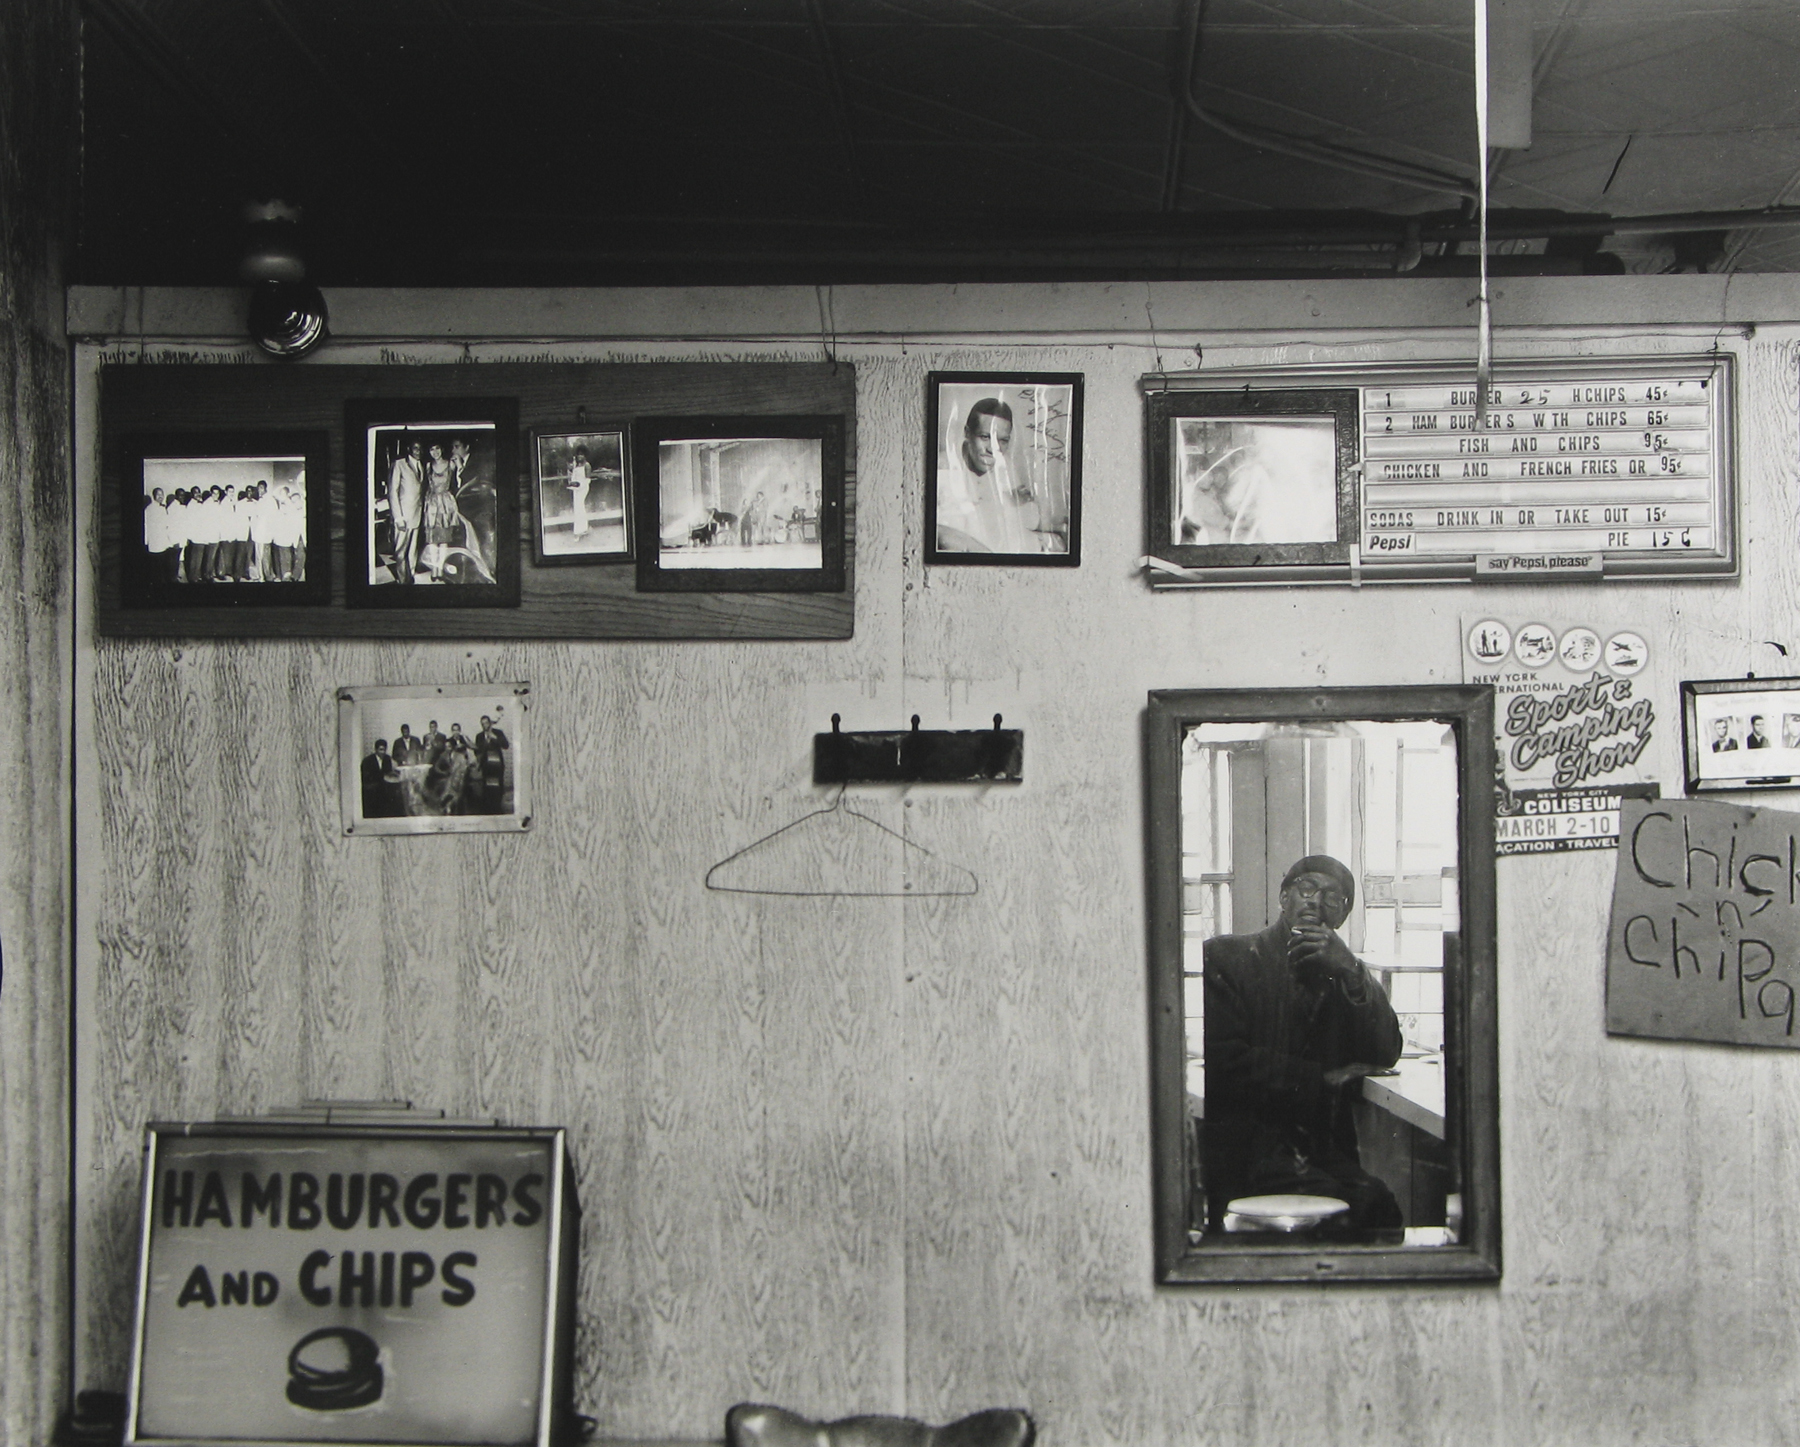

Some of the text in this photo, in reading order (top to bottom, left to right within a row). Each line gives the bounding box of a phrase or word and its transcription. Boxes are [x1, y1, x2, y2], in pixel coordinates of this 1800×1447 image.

[1385, 392, 1392, 407] 1
[1451, 389, 1502, 405] BURER
[1646, 386, 1668, 401] 45¢
[1385, 416, 1393, 431] 2
[1412, 415, 1438, 430] HAM
[1450, 413, 1514, 431] BURERS
[1586, 410, 1627, 427] CHIPS
[1647, 410, 1668, 426] 65¢
[1459, 438, 1489, 453] FISH
[1512, 437, 1537, 453] AND
[1558, 435, 1600, 451] CHIPS
[1383, 455, 1682, 479] CHICKEN AND FRENCH FRIES OR 95¢
[1369, 507, 1667, 528] SODAS DRINK IN OR TAKE OUT 15¢
[1368, 534, 1412, 552] Pepsi
[1608, 531, 1630, 547] PIE
[1488, 558, 1509, 571] say
[1472, 672, 1538, 685] NEW YORK
[1504, 671, 1613, 736] Sport
[1510, 699, 1655, 771] Camping
[1552, 732, 1652, 789] Show
[1536, 789, 1609, 799] NEW YORK CITY
[1523, 795, 1622, 815] COLISEUM
[1496, 815, 1610, 838] MARCH 2-10
[1495, 840, 1555, 855] ACATION
[161, 1168, 545, 1230] HAMBURGERS
[176, 1249, 478, 1309] AND CHIPS
